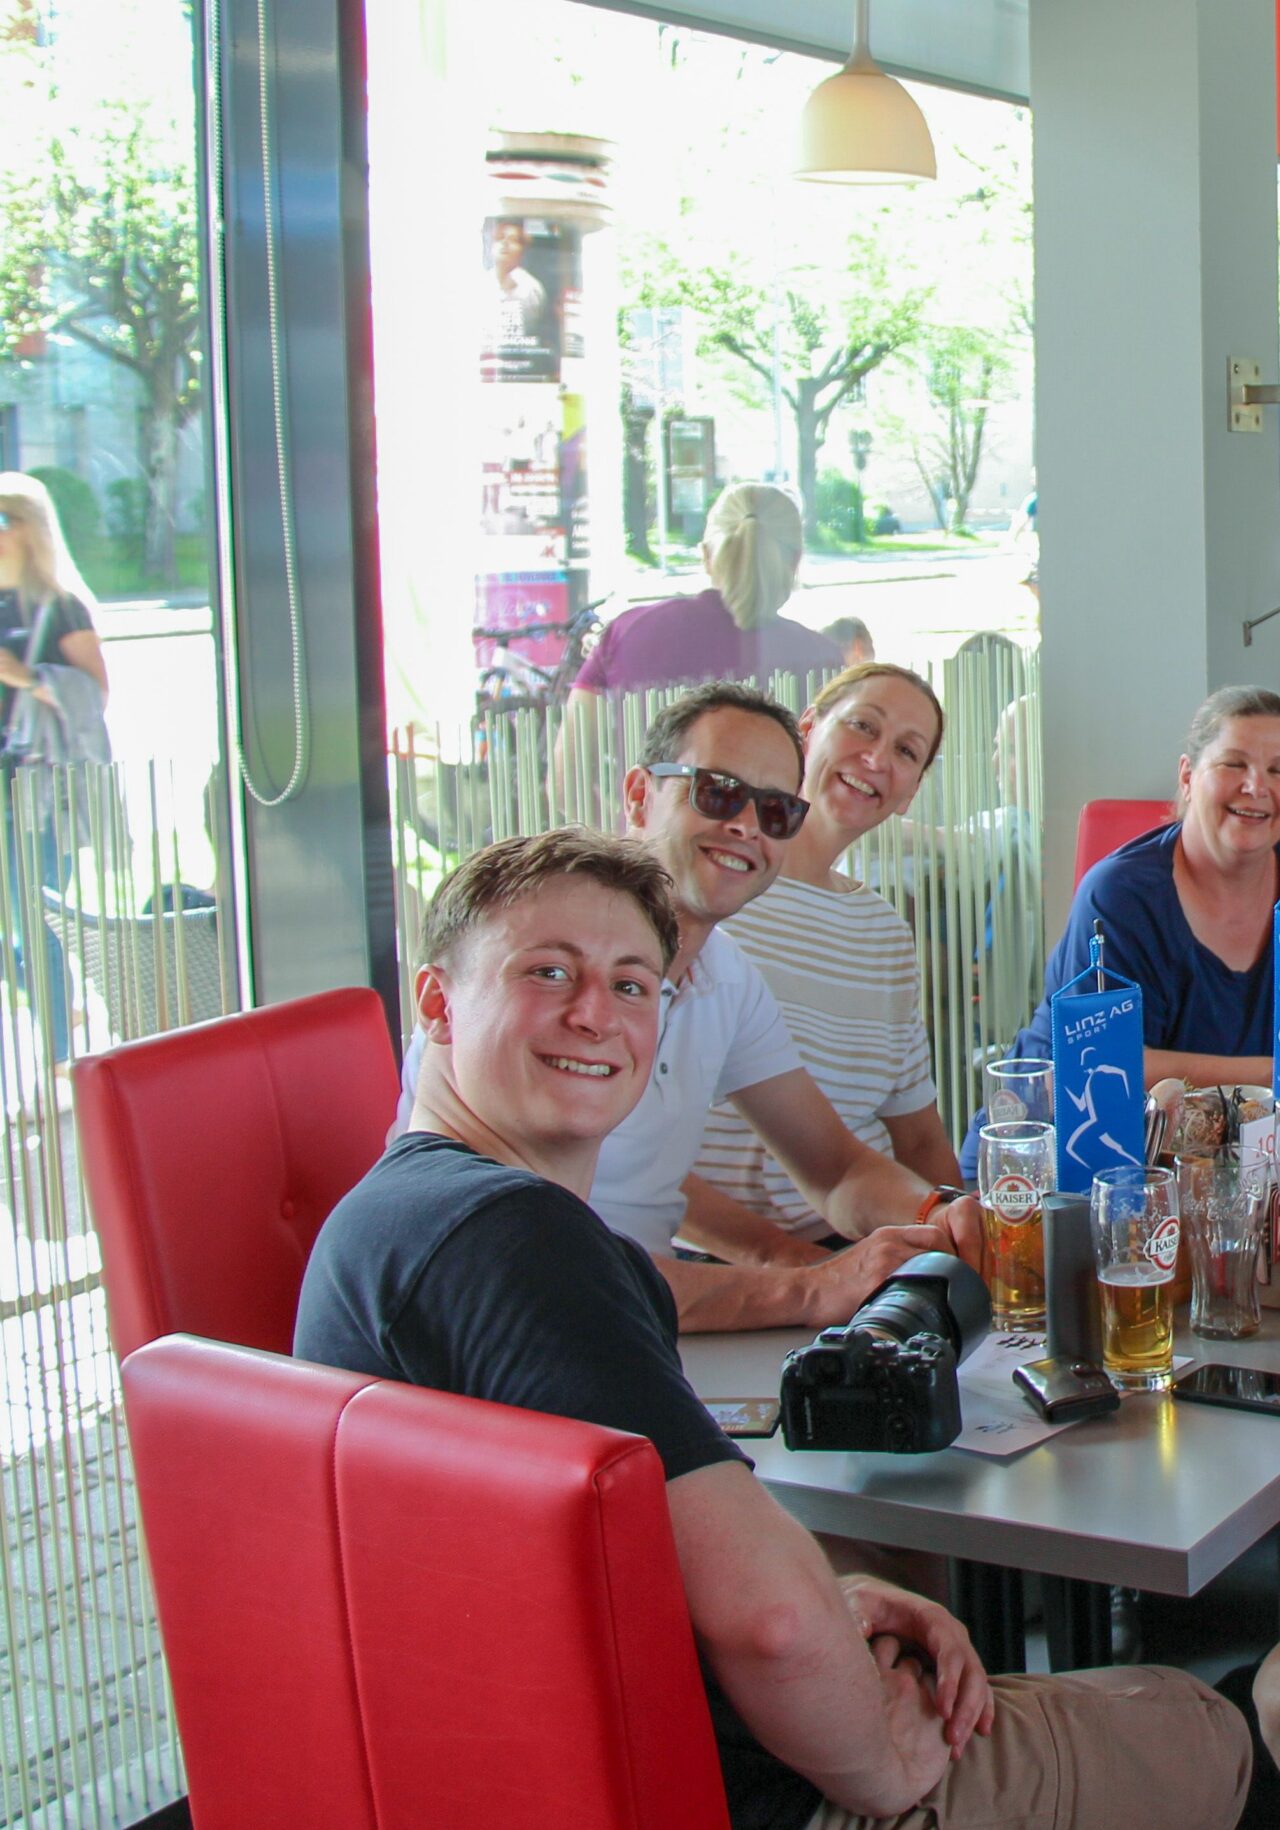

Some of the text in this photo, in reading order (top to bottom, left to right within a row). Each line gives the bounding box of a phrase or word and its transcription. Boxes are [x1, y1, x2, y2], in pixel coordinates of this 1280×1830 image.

[1064, 999, 1134, 1036] LINZ AG
[1067, 1023, 1107, 1044] SPORT
[995, 1193, 1033, 1204] KAISER
